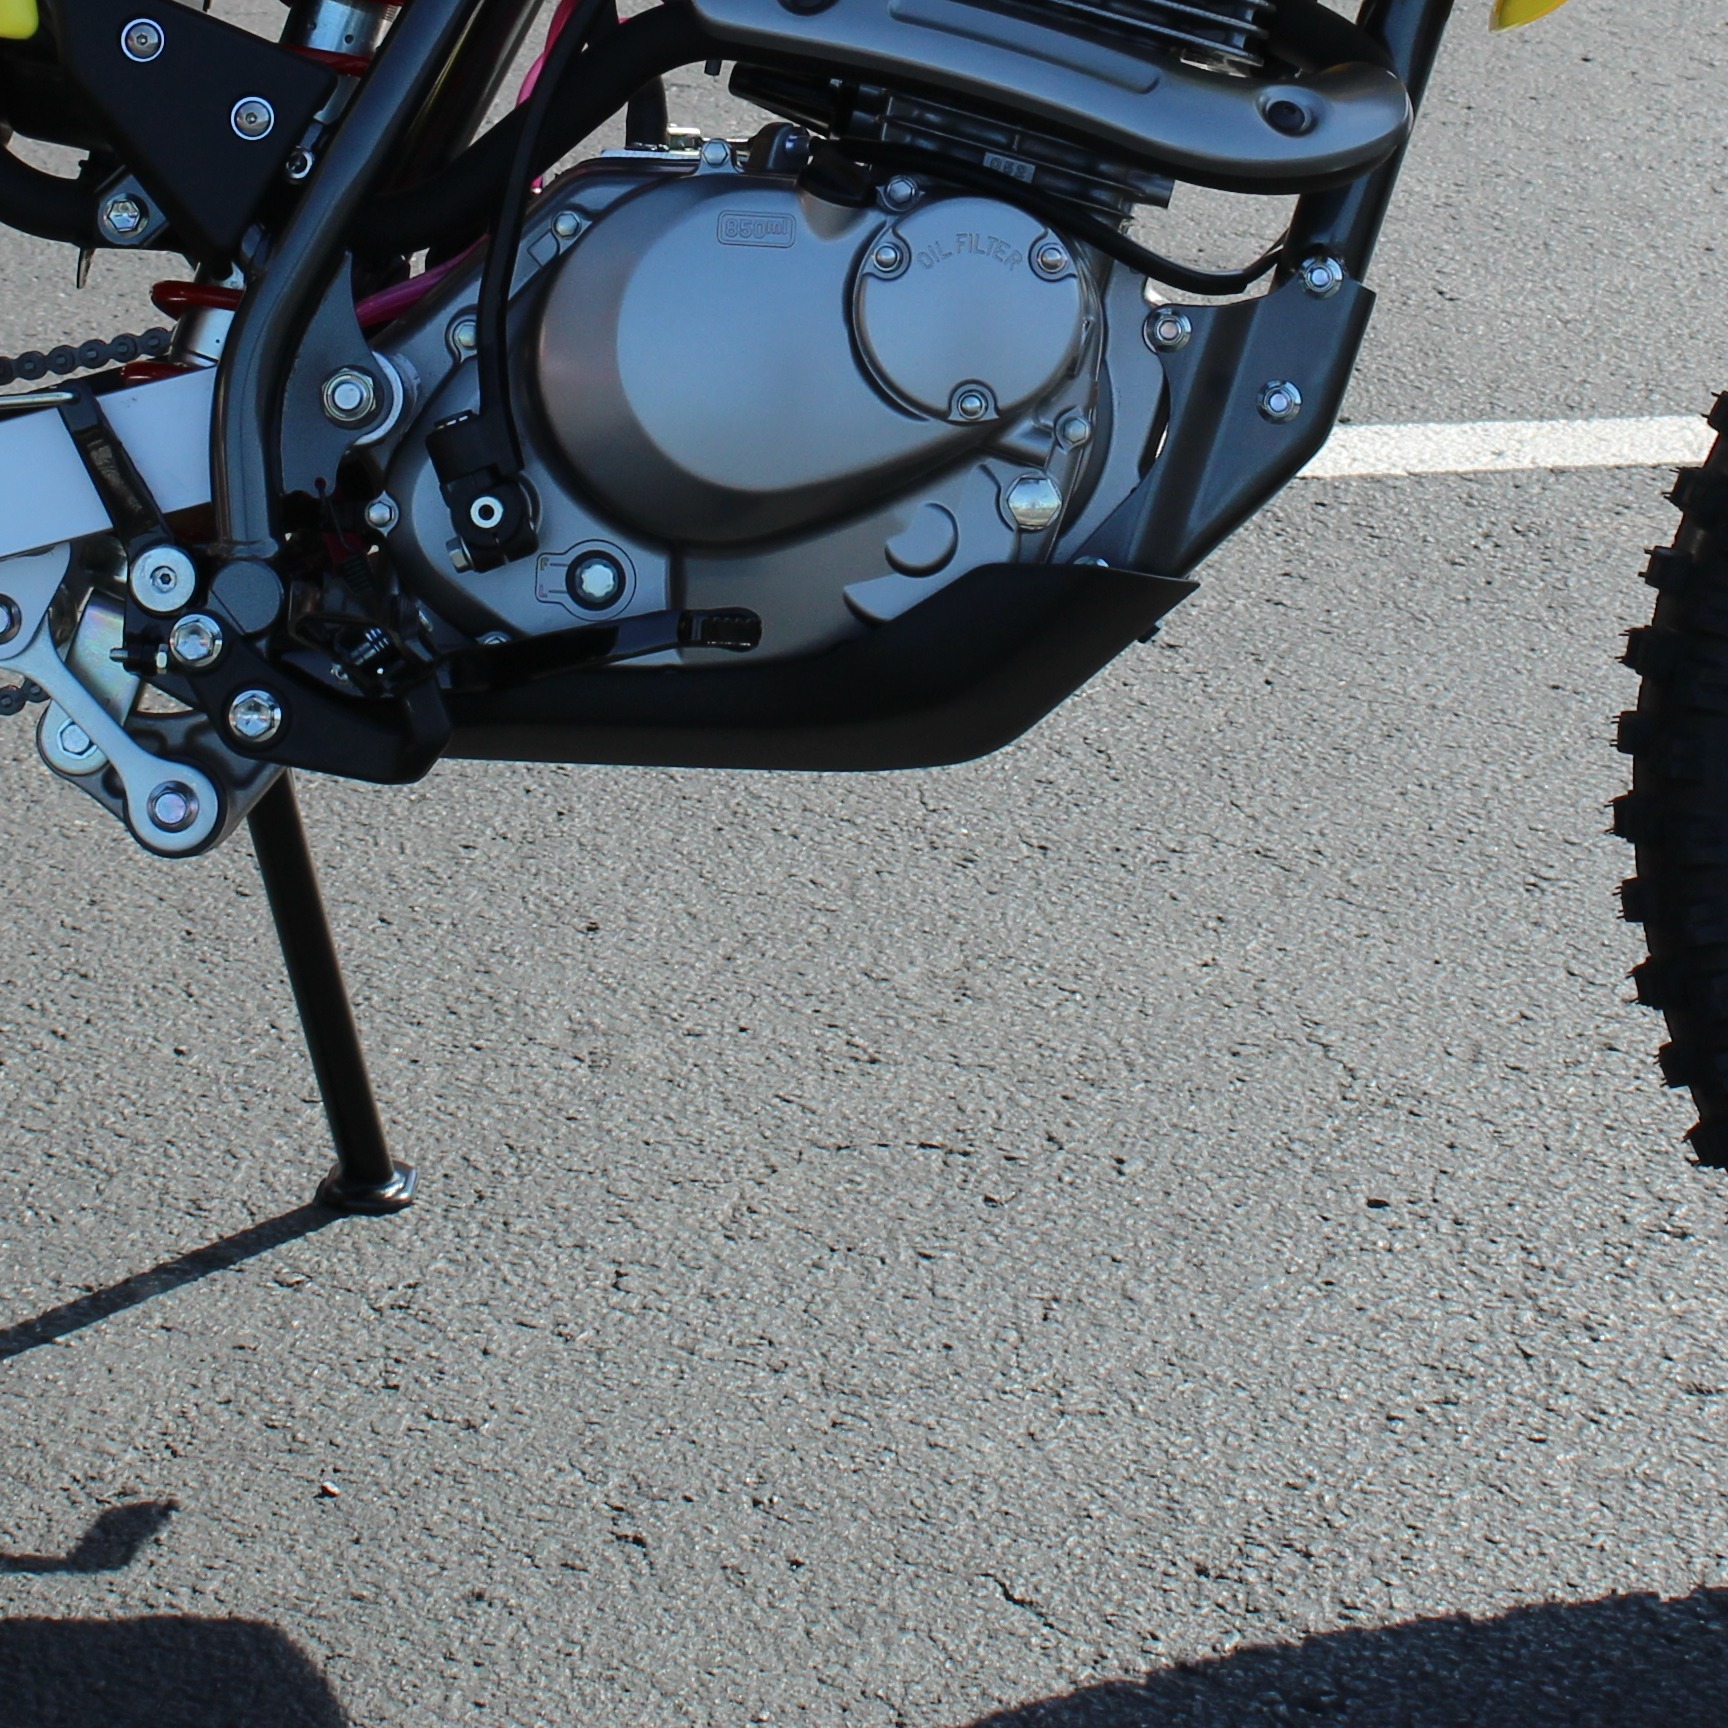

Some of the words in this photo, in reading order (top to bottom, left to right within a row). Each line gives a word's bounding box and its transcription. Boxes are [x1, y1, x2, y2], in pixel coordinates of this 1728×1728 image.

[723, 217, 788, 240] 850ml
[916, 240, 954, 271] OIL
[955, 232, 1024, 272] FILTER
